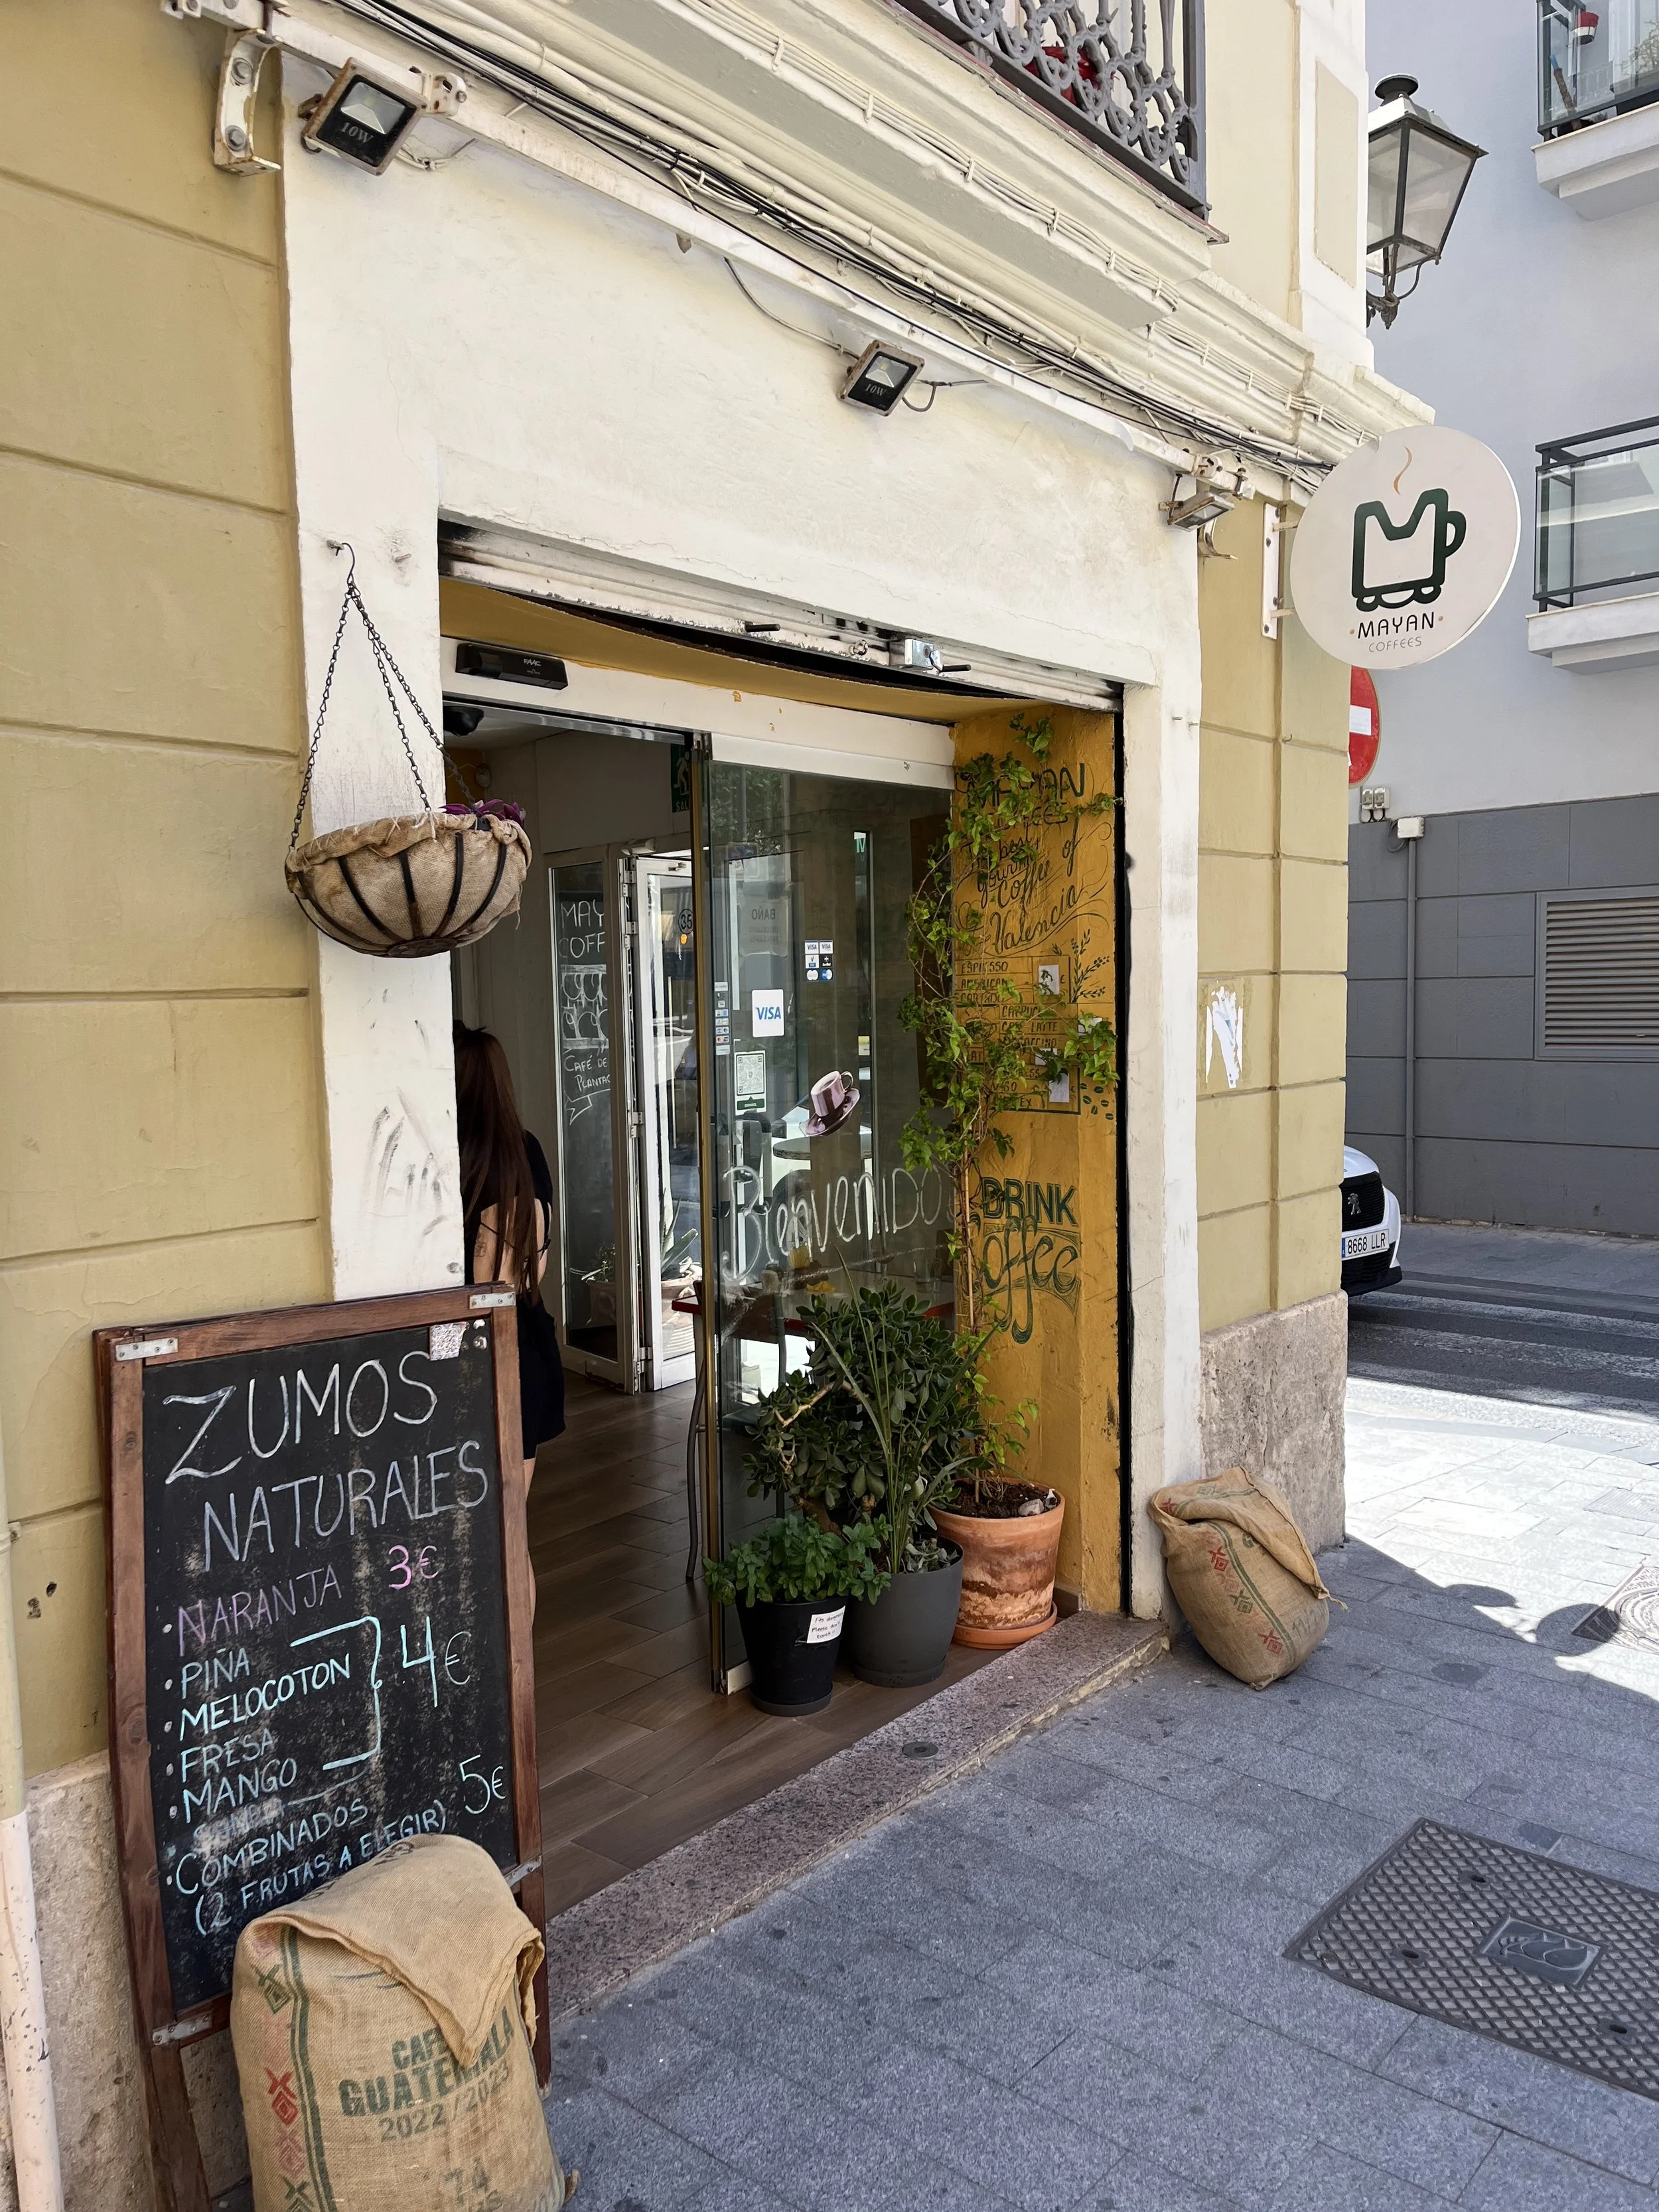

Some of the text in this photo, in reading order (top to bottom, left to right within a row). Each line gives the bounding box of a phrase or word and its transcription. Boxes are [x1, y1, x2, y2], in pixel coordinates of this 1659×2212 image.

[340, 121, 374, 144] 10W
[865, 383, 887, 397] 10W
[1358, 611, 1435, 639] MAYAN
[1368, 636, 1423, 653] COFFEES
[676, 800, 690, 812] SAL
[559, 899, 605, 929] MAY
[681, 914, 693, 929] 35
[989, 885, 1082, 956] Valencia
[558, 930, 606, 958] COFF
[755, 1006, 781, 1020] VISA
[1031, 1021, 1058, 1033] LATTE
[574, 1074, 611, 1092] PLANTAC
[981, 1177, 1079, 1226] DRINK
[1348, 1232, 1386, 1254] 8668 LLR
[163, 1350, 439, 1484] ZUMOS
[204, 1440, 490, 1572] NATURALES
[178, 1564, 343, 1657] NARANJA
[180, 1647, 250, 1699] PIÑA
[179, 1653, 351, 1741] MELOCOTON
[180, 1728, 275, 1783] FRESA
[182, 1757, 298, 1823] MANGO
[175, 1797, 369, 1895] COMBINADOS
[241, 1854, 330, 1909] FRUTAS
[339, 1845, 352, 1869] A
[392, 2027, 447, 2070] CAF
